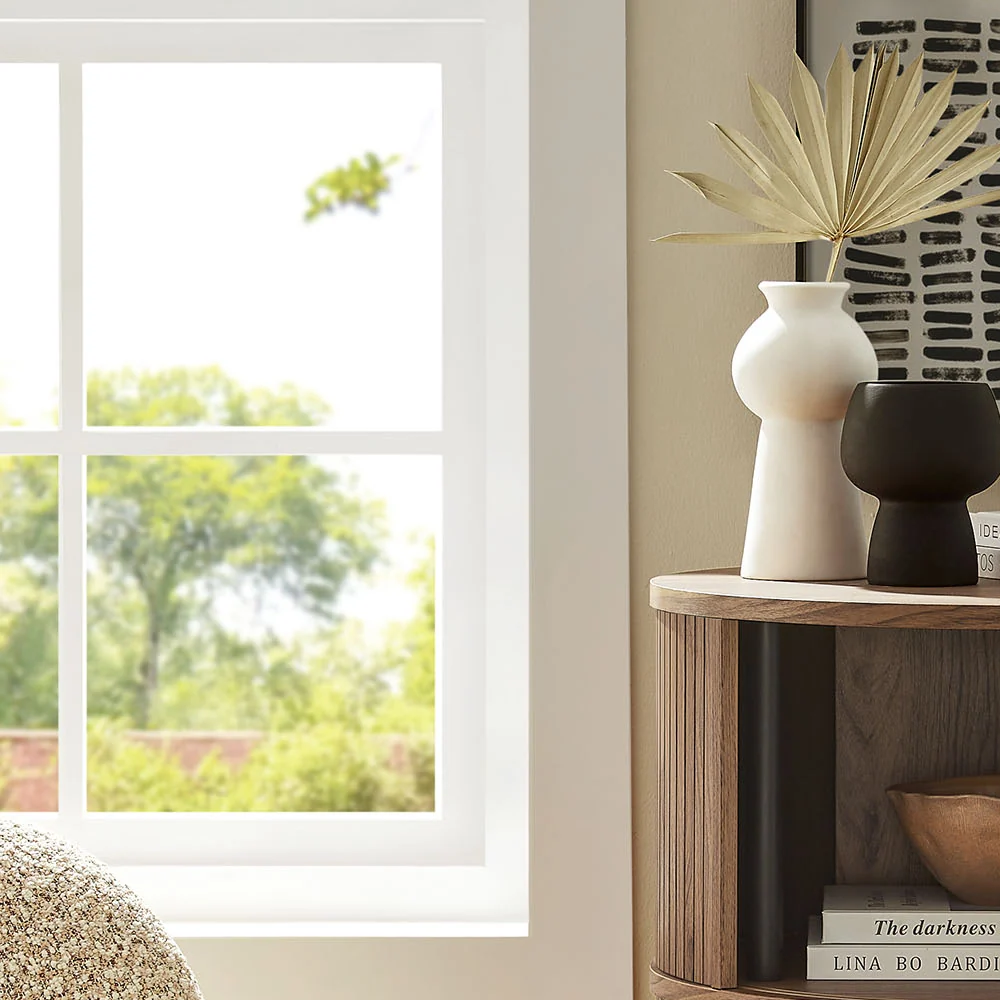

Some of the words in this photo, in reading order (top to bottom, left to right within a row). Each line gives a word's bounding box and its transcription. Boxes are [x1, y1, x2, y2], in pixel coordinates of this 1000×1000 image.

[976, 552, 994, 572] OS
[874, 919, 908, 936] The
[912, 919, 996, 936] darkness
[833, 956, 882, 971] LINA
[895, 956, 922, 971] BO
[936, 956, 1000, 971] BARDI
